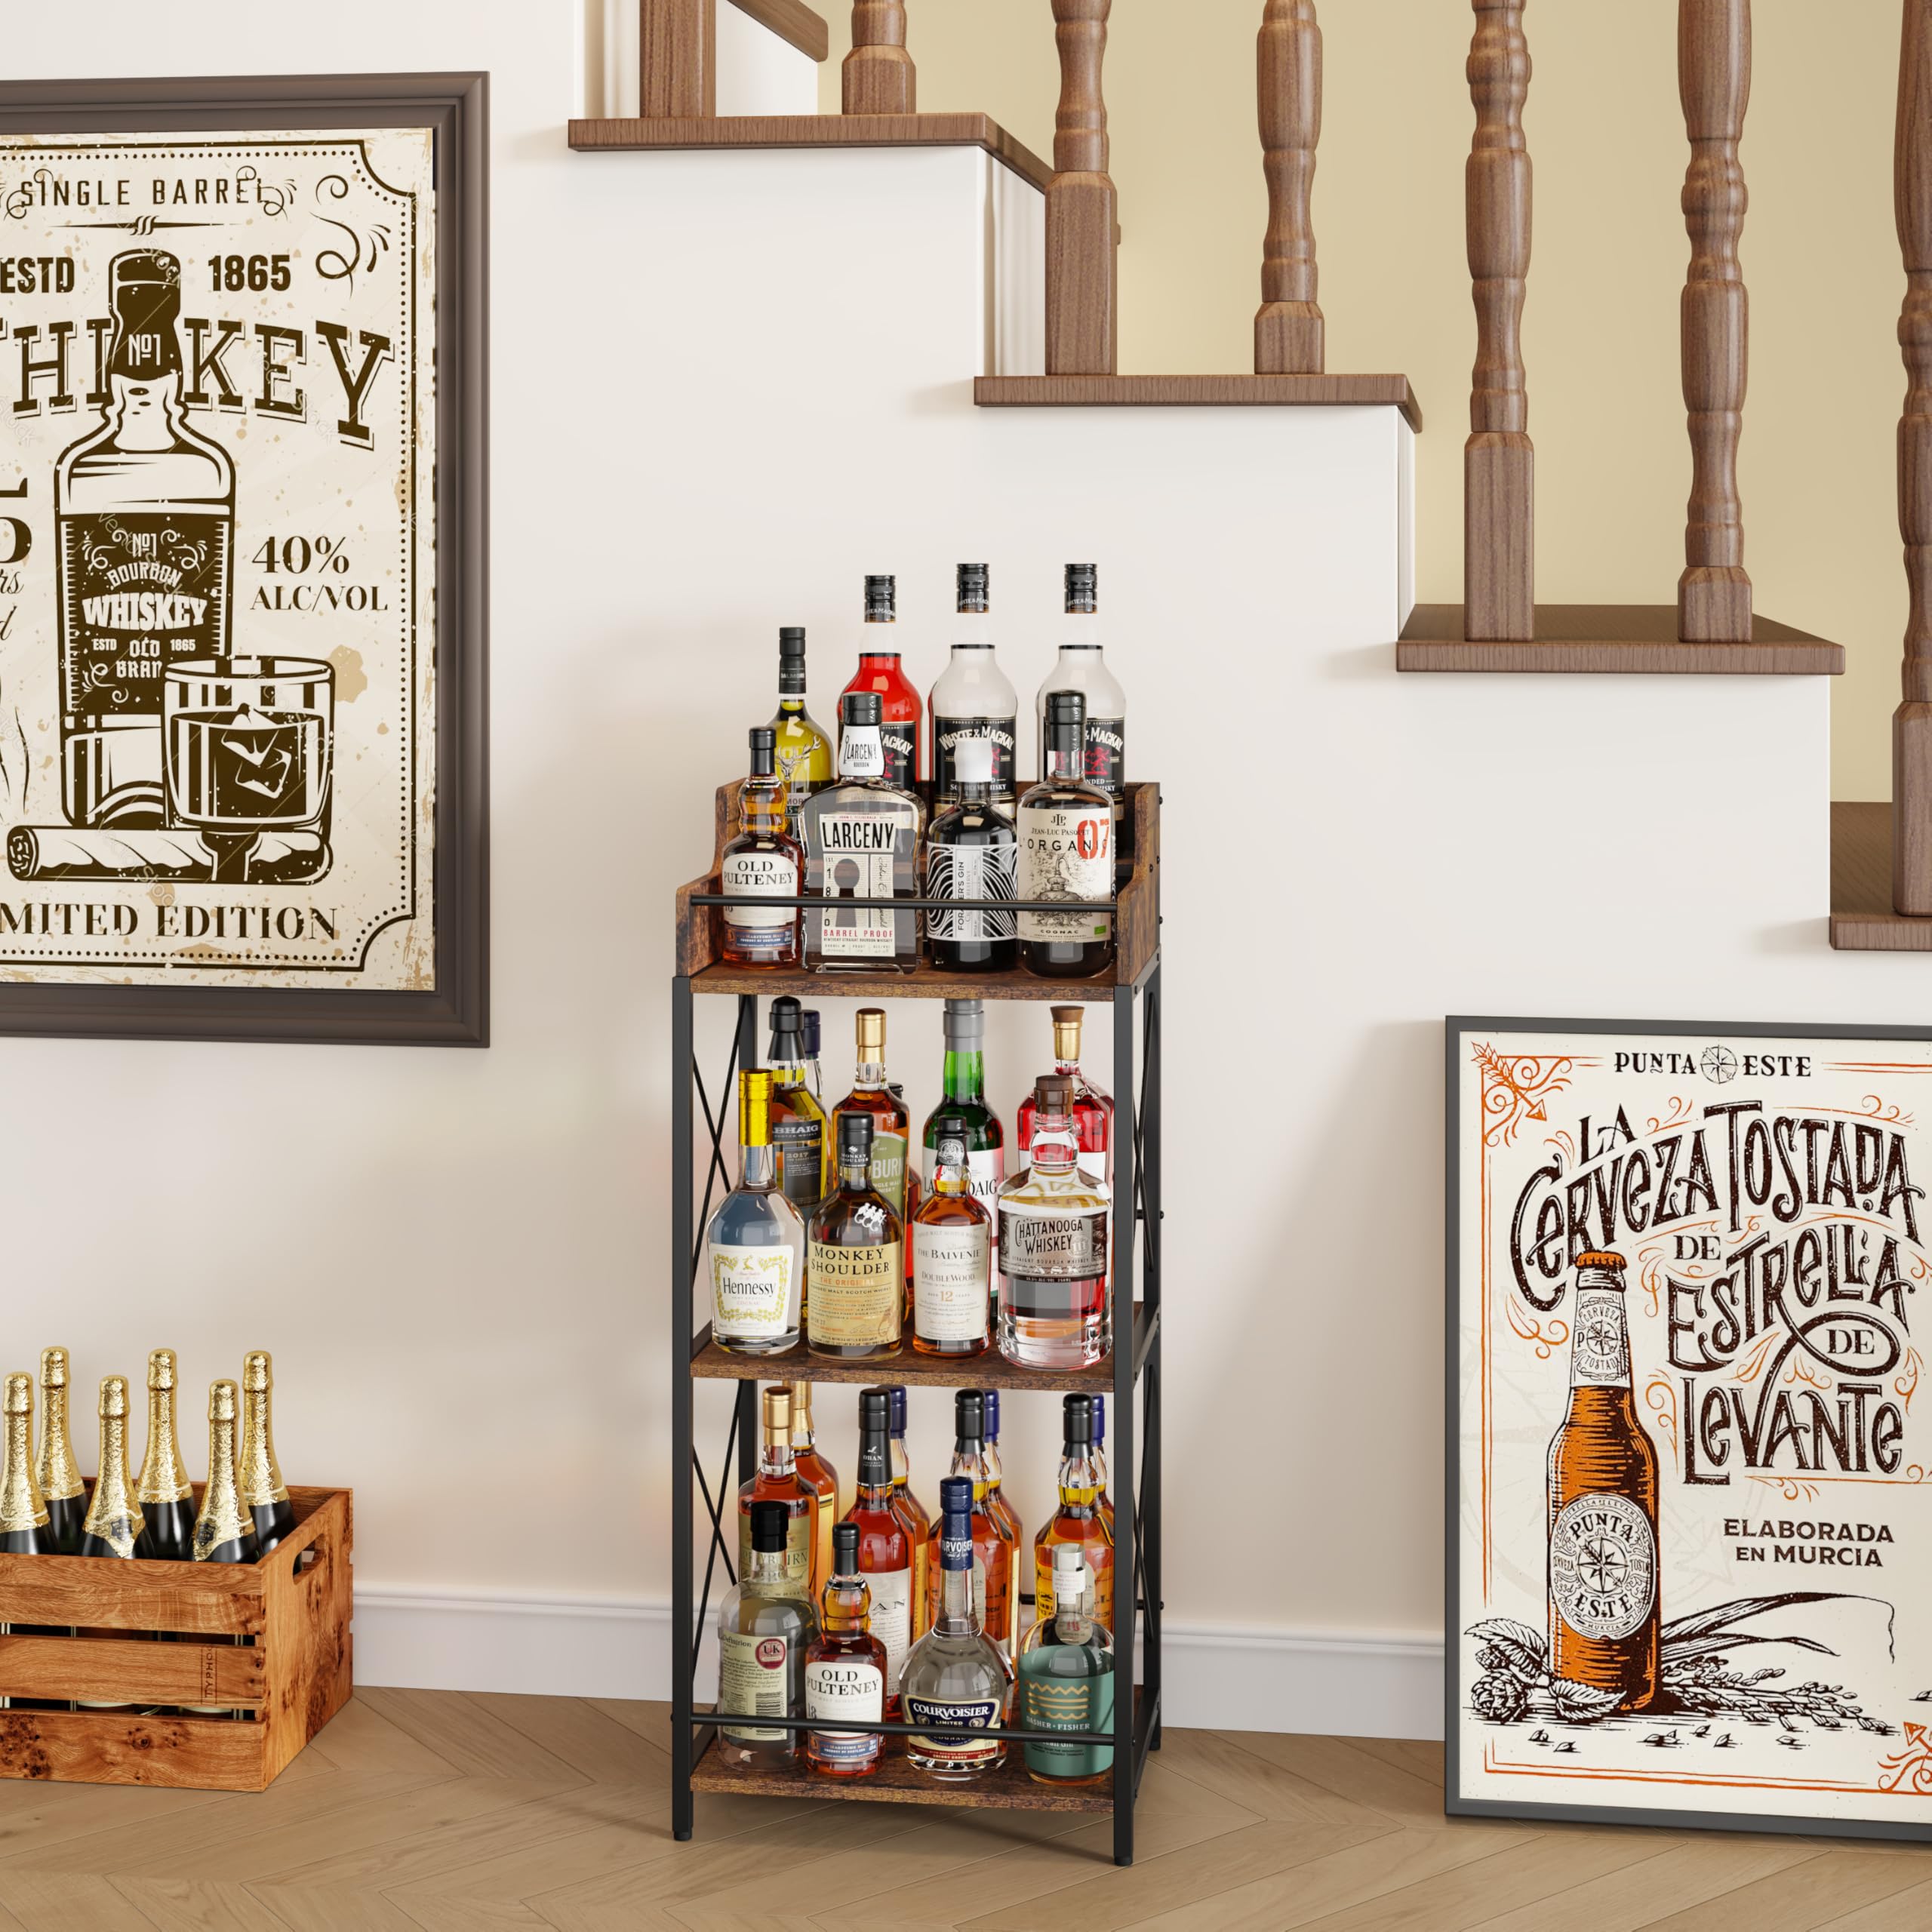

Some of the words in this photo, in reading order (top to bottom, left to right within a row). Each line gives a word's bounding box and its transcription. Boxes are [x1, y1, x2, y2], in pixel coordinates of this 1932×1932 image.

[20, 180, 131, 206] SINGLE
[152, 178, 269, 205] BARREL
[0, 257, 75, 294] ESTD
[208, 254, 291, 292] 1865
[251, 536, 350, 574] 40%
[106, 561, 183, 588] BOURBON
[250, 585, 388, 611] ALC/VOL
[82, 592, 208, 631] WHISKEY
[92, 638, 117, 651] ESTD
[170, 638, 196, 651] 1865
[115, 660, 163, 678] BRAN
[938, 728, 973, 751] WHYTE
[982, 725, 1014, 751] MACKAY
[1091, 727, 1123, 752] MACKAY
[847, 742, 877, 760] LARCENY
[822, 822, 894, 849] LARCENY
[1031, 827, 1060, 835] JEAN-LUC
[1077, 818, 1110, 860] 07
[724, 872, 794, 885] PULTENEY
[738, 860, 774, 872] OLD
[155, 905, 338, 940] EDITION
[823, 929, 858, 937] BARREL
[863, 930, 894, 938] PROOF
[1614, 1052, 1697, 1075] PUNTA
[1743, 1054, 1811, 1077] ESTE
[1579, 1103, 1638, 1166] LA
[1703, 1100, 1927, 1249] TOSTADA
[1015, 1219, 1084, 1247] CHATTANOOGA
[1025, 1233, 1072, 1256] WHISKEY
[814, 1244, 884, 1261] MONKEY
[918, 1247, 929, 1257] THE
[931, 1248, 982, 1260] BALVENIE
[1674, 1235, 1722, 1260] DE
[811, 1258, 890, 1275] SHOULDER
[723, 1276, 777, 1298] Hennessy
[940, 1291, 953, 1303] 12
[1826, 1329, 1875, 1355] DE
[1569, 1513, 1633, 1543] PUNTA
[1723, 1518, 1895, 1543] ELABORADA
[1736, 1546, 1765, 1561] EN
[1774, 1545, 1884, 1567] MURCIA
[1574, 1593, 1633, 1618] ESTE
[807, 1675, 879, 1696] PULTENEY
[821, 1669, 858, 1682] OLD
[913, 1703, 990, 1720] COURVOISIER
